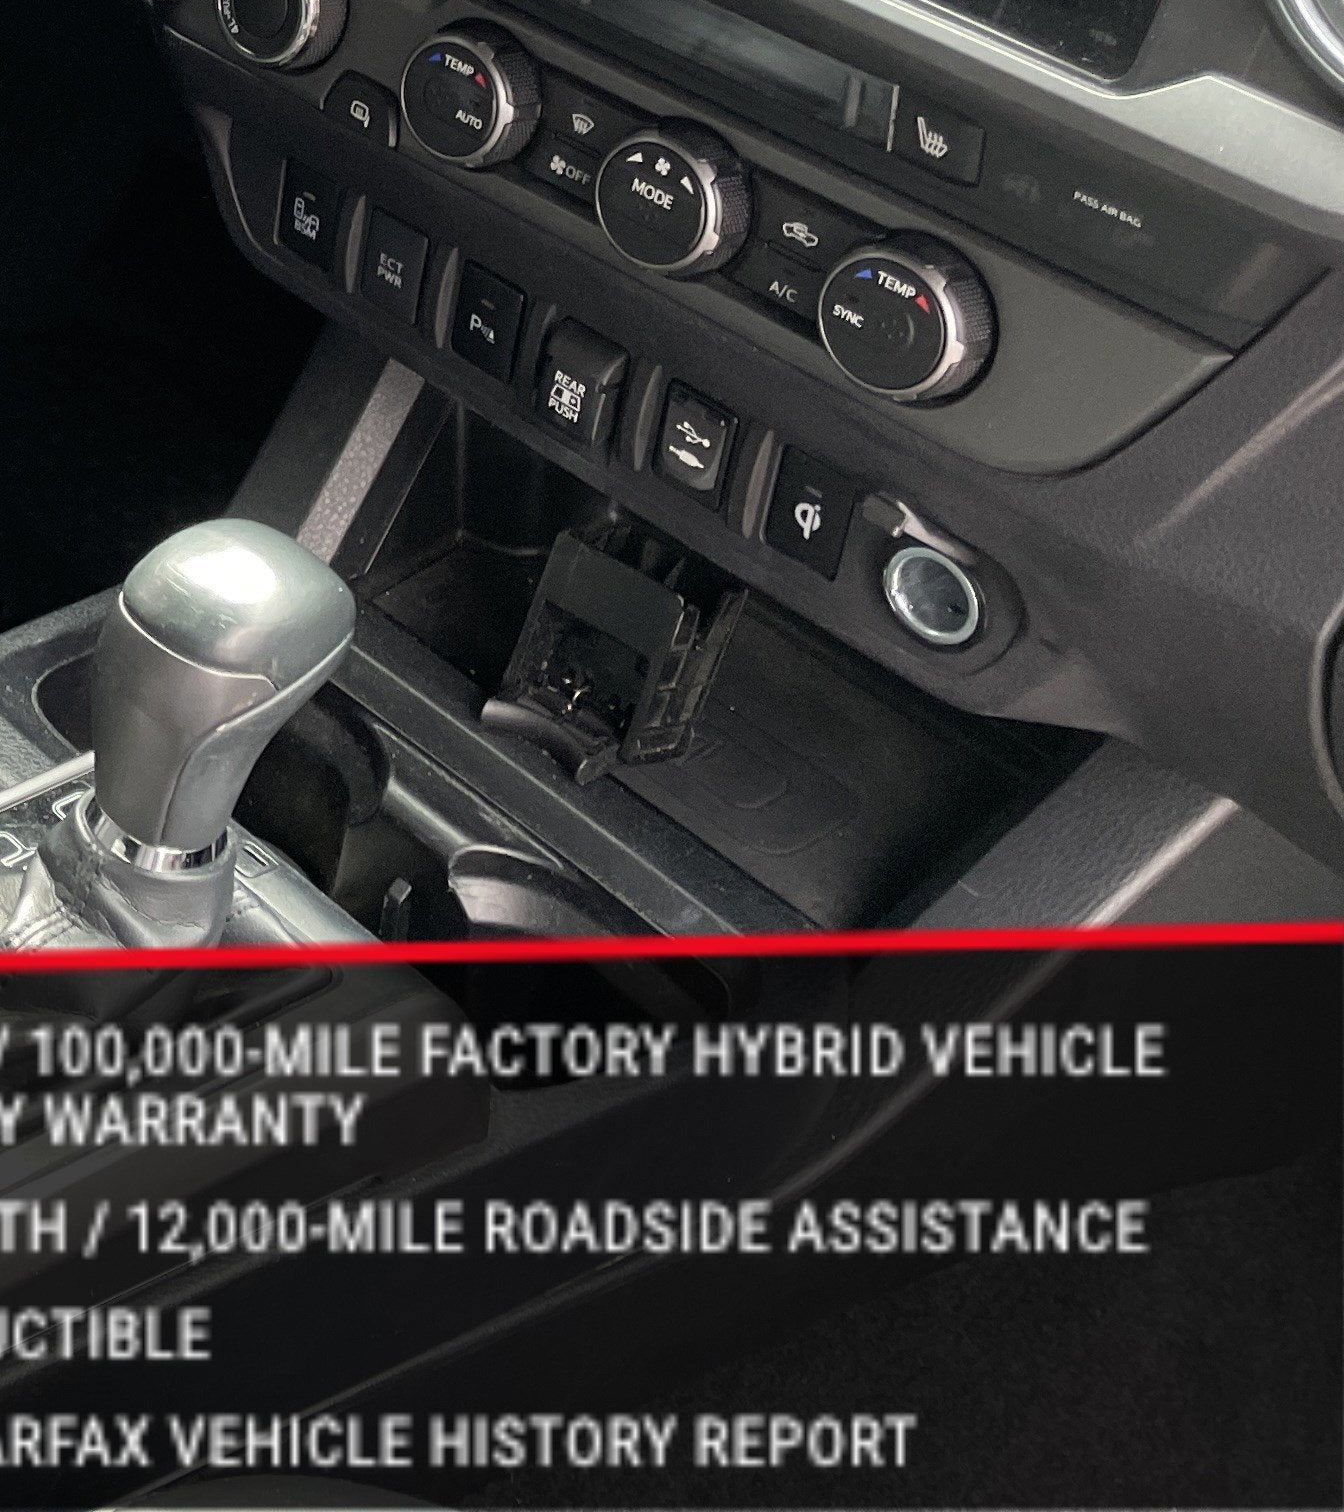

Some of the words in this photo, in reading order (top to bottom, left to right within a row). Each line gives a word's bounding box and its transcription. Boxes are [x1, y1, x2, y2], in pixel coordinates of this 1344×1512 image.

[444, 53, 475, 77] TEMP
[455, 109, 483, 131] AUTO
[565, 164, 591, 186] OFF
[632, 177, 674, 210] MODE
[1073, 190, 1100, 211] PASS
[1100, 203, 1119, 220] AIR
[1119, 211, 1142, 228] BAG
[380, 251, 404, 275] ECT
[376, 264, 403, 290] PWR
[877, 271, 916, 300] TEMP
[769, 279, 798, 303] A/C
[832, 304, 864, 329] SYNC
[554, 370, 586, 398] REAR
[548, 397, 579, 423] PUSH
